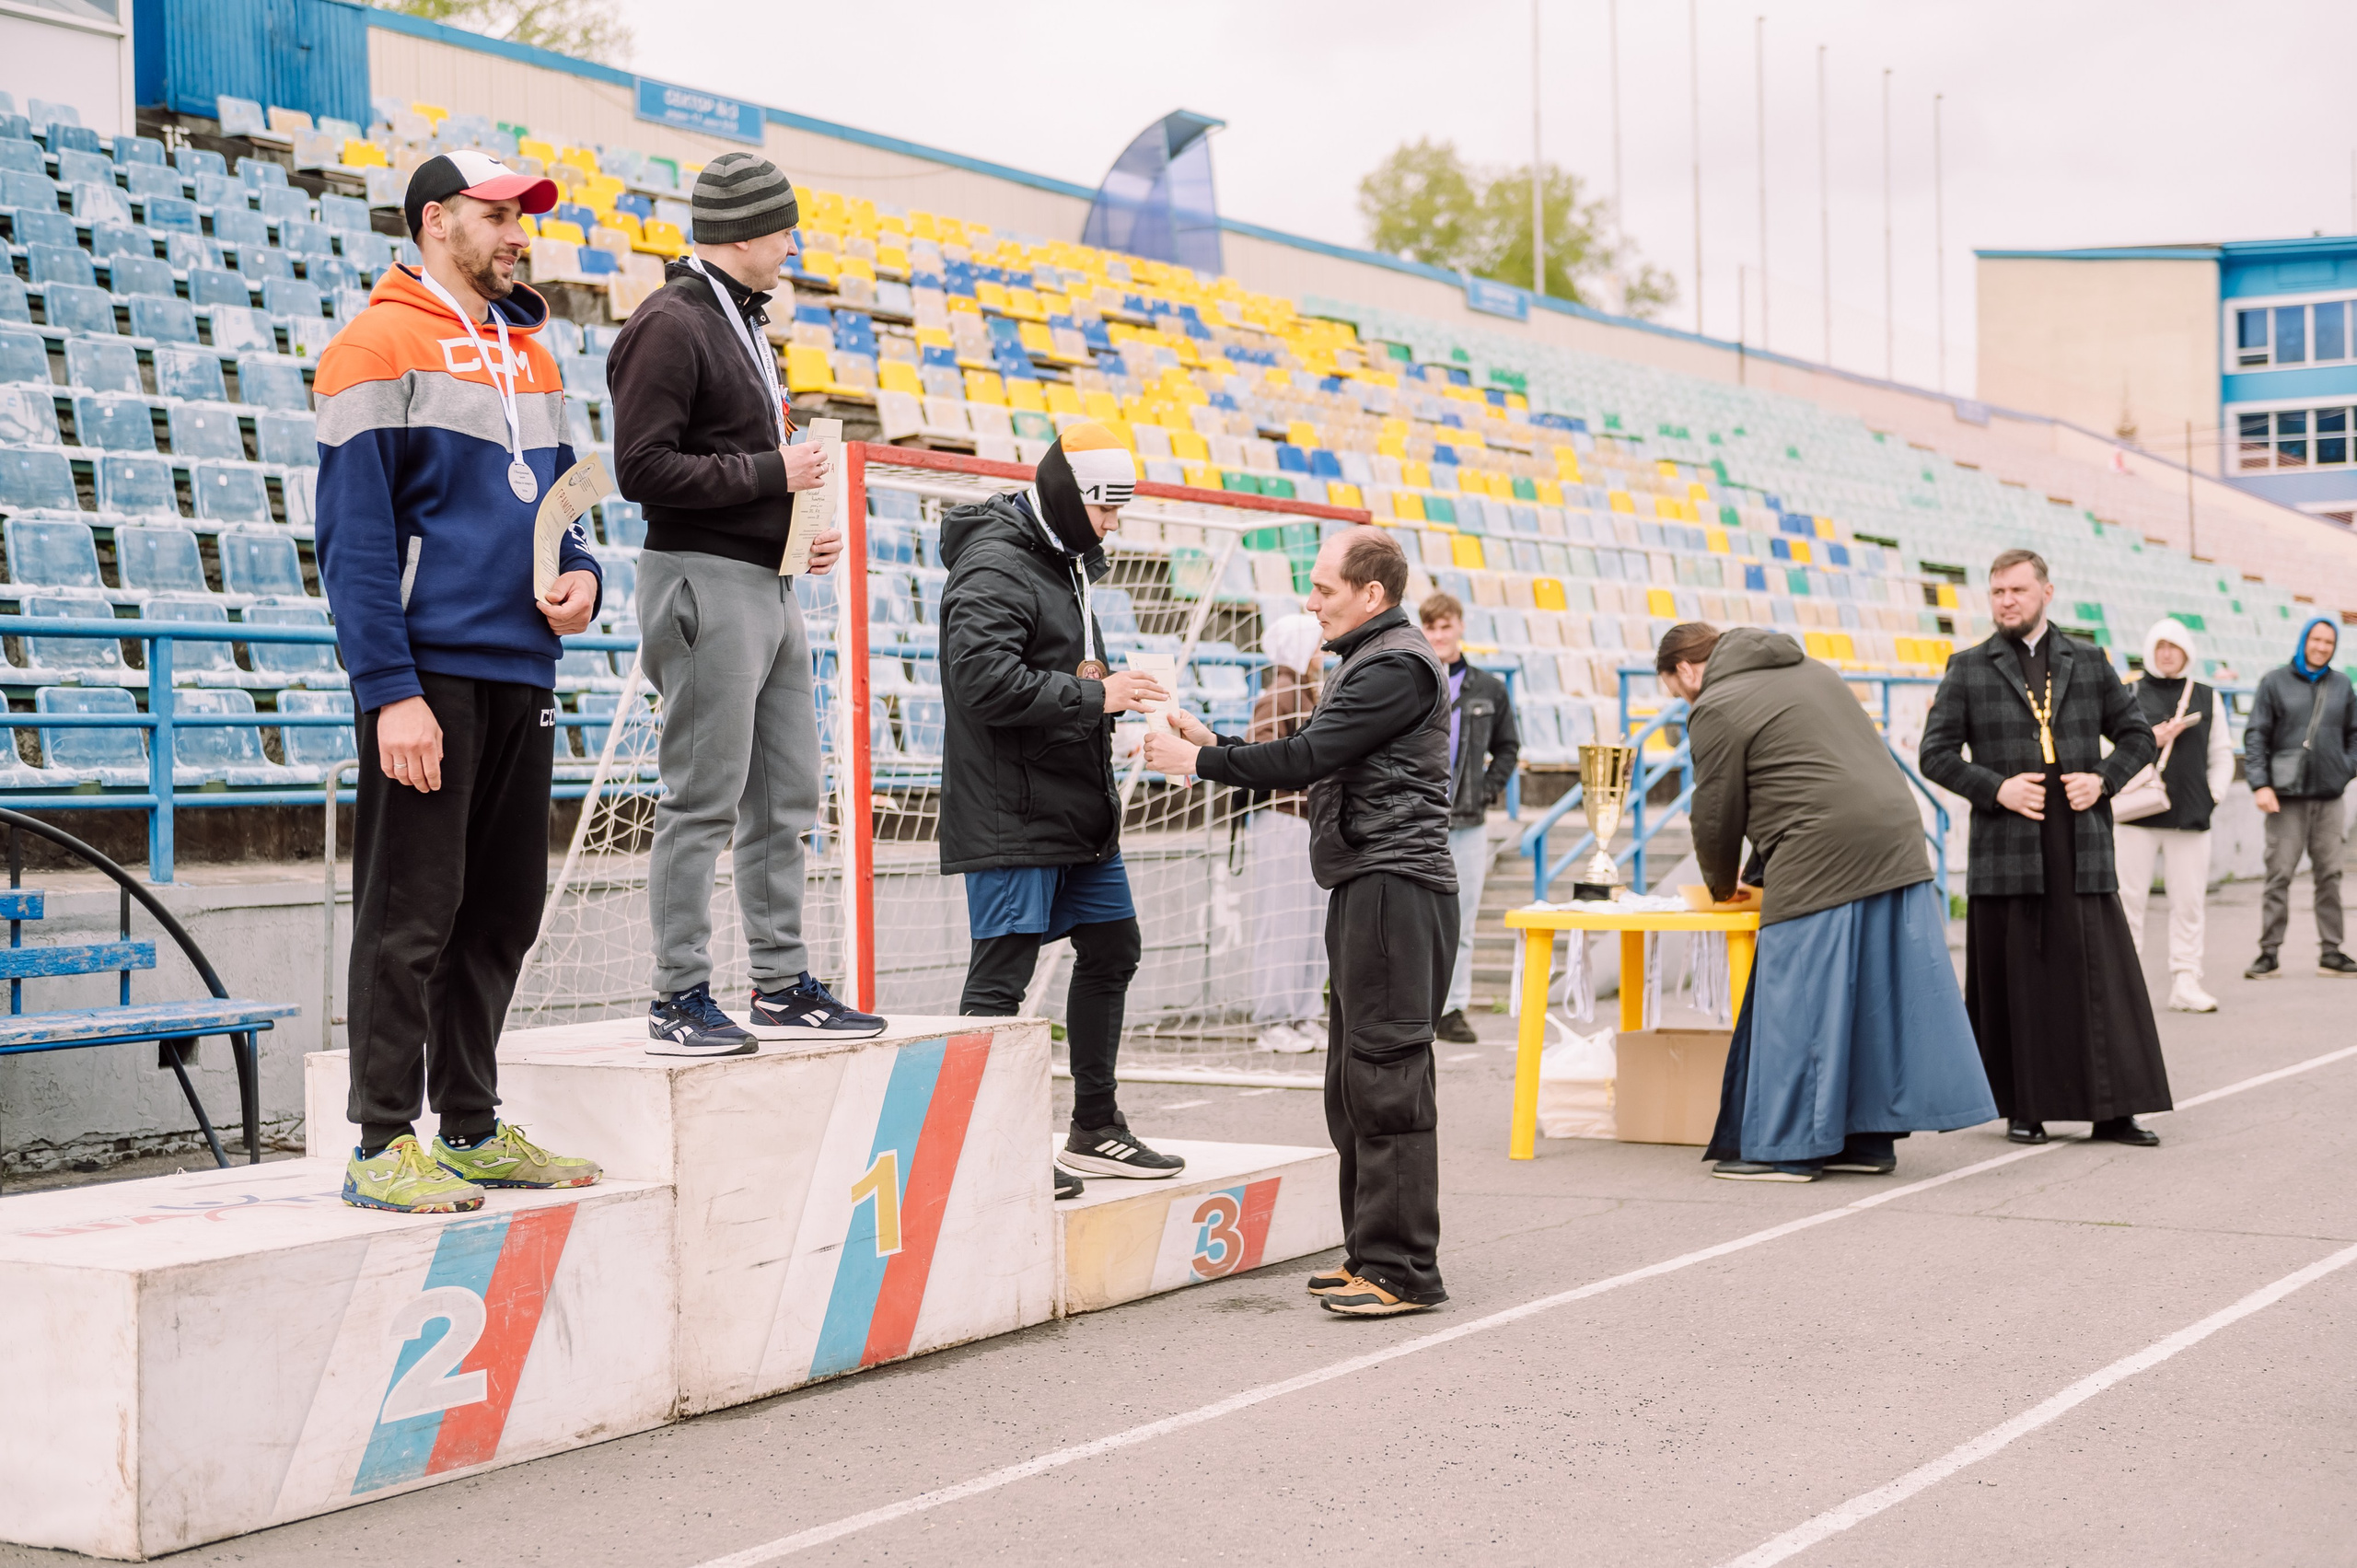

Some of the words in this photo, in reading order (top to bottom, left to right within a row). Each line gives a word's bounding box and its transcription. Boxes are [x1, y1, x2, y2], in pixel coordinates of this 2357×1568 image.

[555, 488, 577, 521] ГРАМОТА
[851, 1149, 903, 1259] 1
[1191, 1192, 1246, 1279] 3
[380, 1285, 488, 1425] 2
